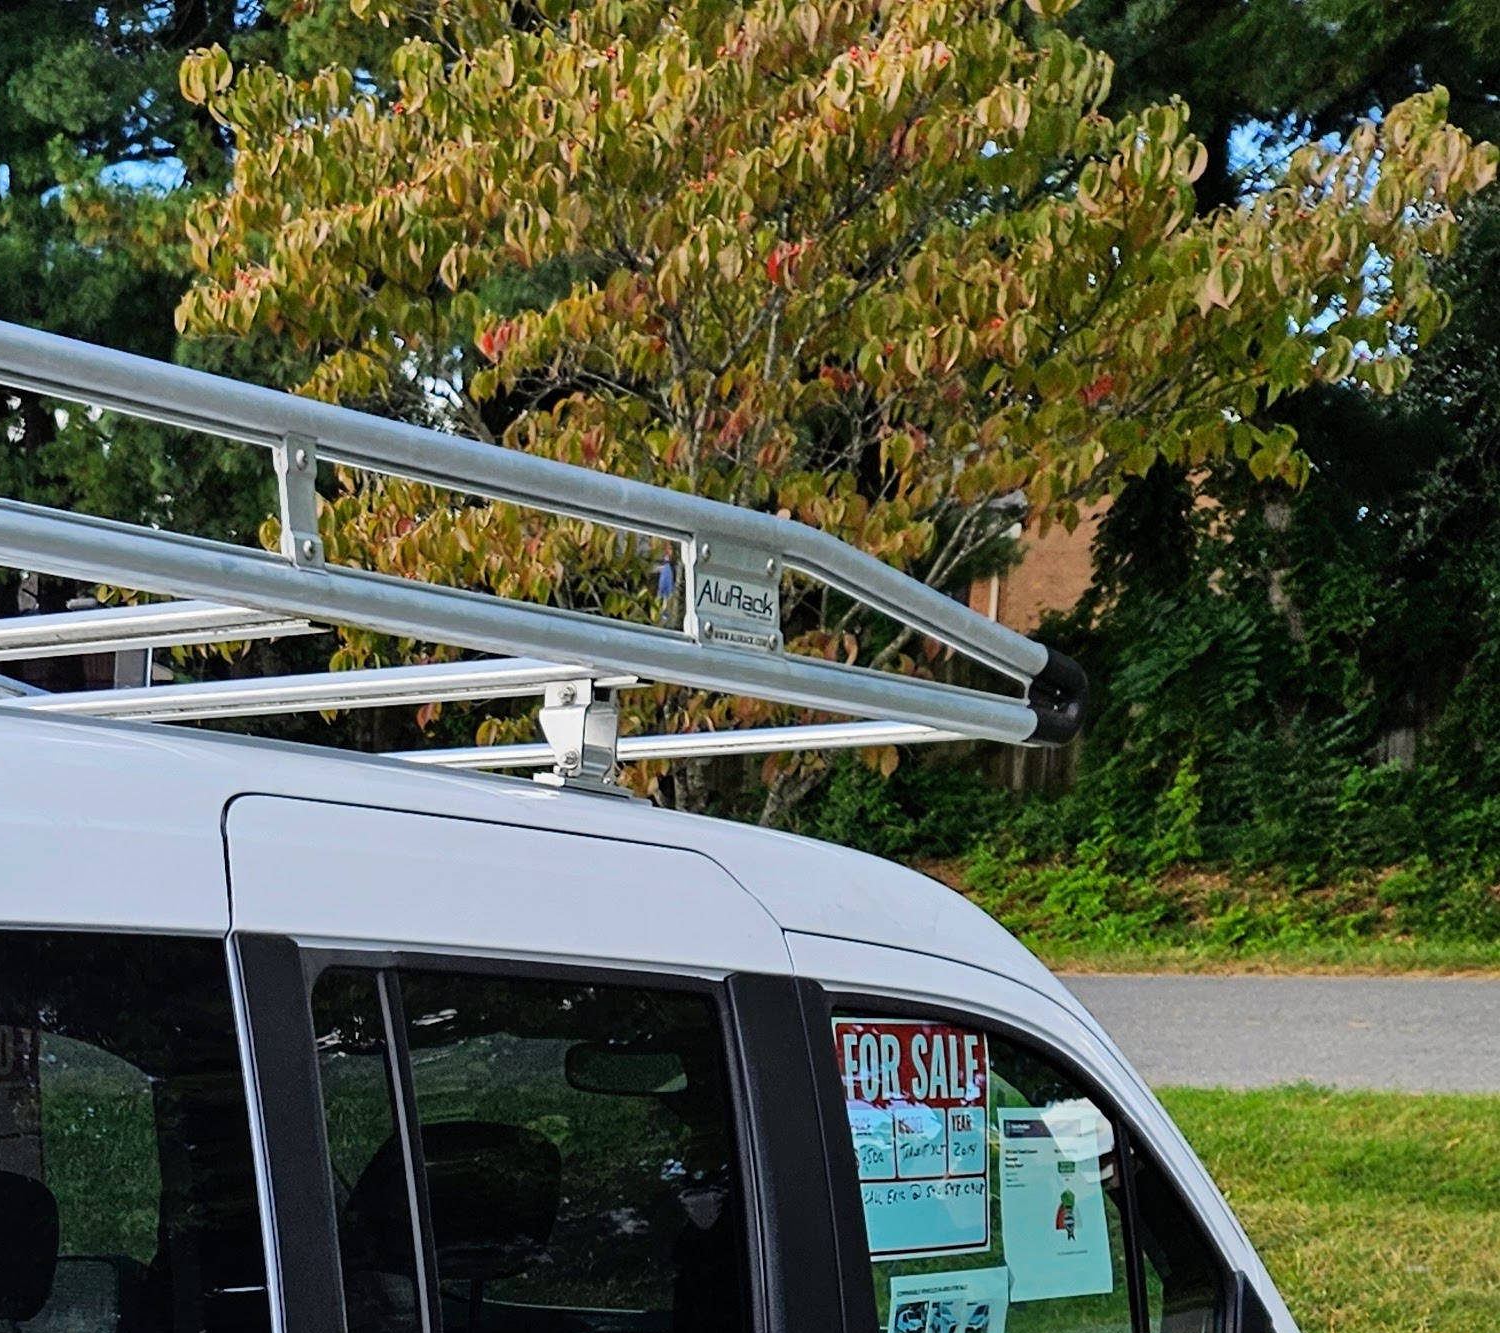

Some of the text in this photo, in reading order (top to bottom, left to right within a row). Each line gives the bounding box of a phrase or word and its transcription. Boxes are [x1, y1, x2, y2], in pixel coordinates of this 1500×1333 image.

[697, 579, 774, 616] AluRack
[843, 1033, 981, 1102] FOR SALE
[951, 1115, 972, 1132] YEAR
[953, 1142, 978, 1157] 2014
